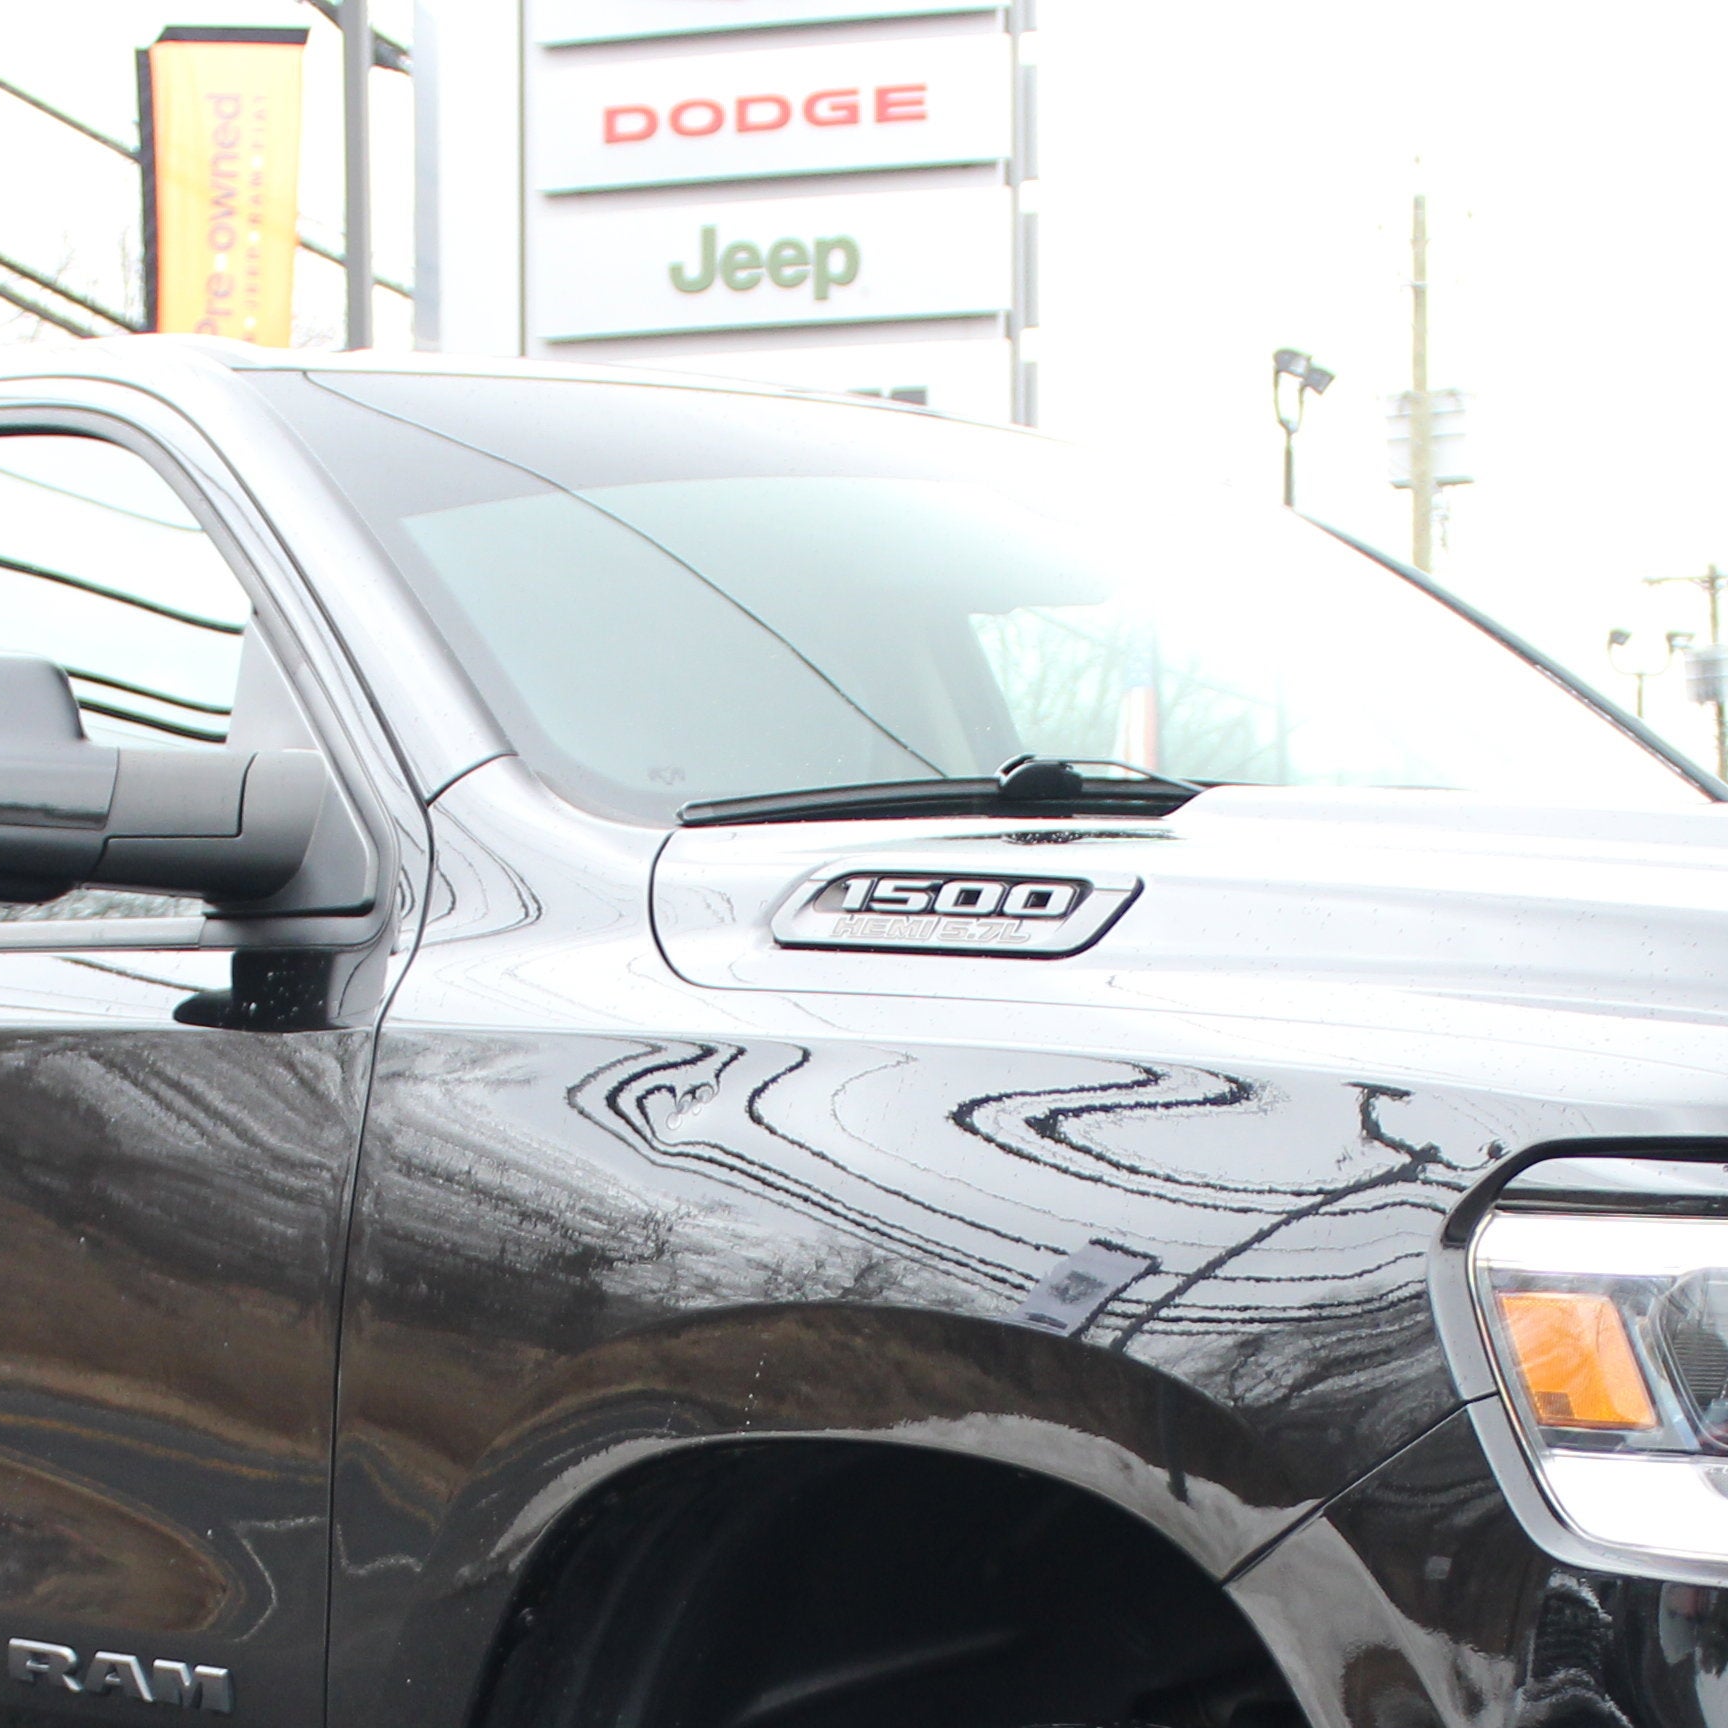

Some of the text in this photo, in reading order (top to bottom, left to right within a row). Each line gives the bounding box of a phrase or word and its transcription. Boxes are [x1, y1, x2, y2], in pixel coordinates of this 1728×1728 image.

[602, 83, 930, 146] DODGE
[669, 224, 861, 300] Jeep
[839, 875, 1079, 917] 1500
[831, 916, 1031, 943] HEMI 5.7L
[8, 1637, 234, 1714] RAM
